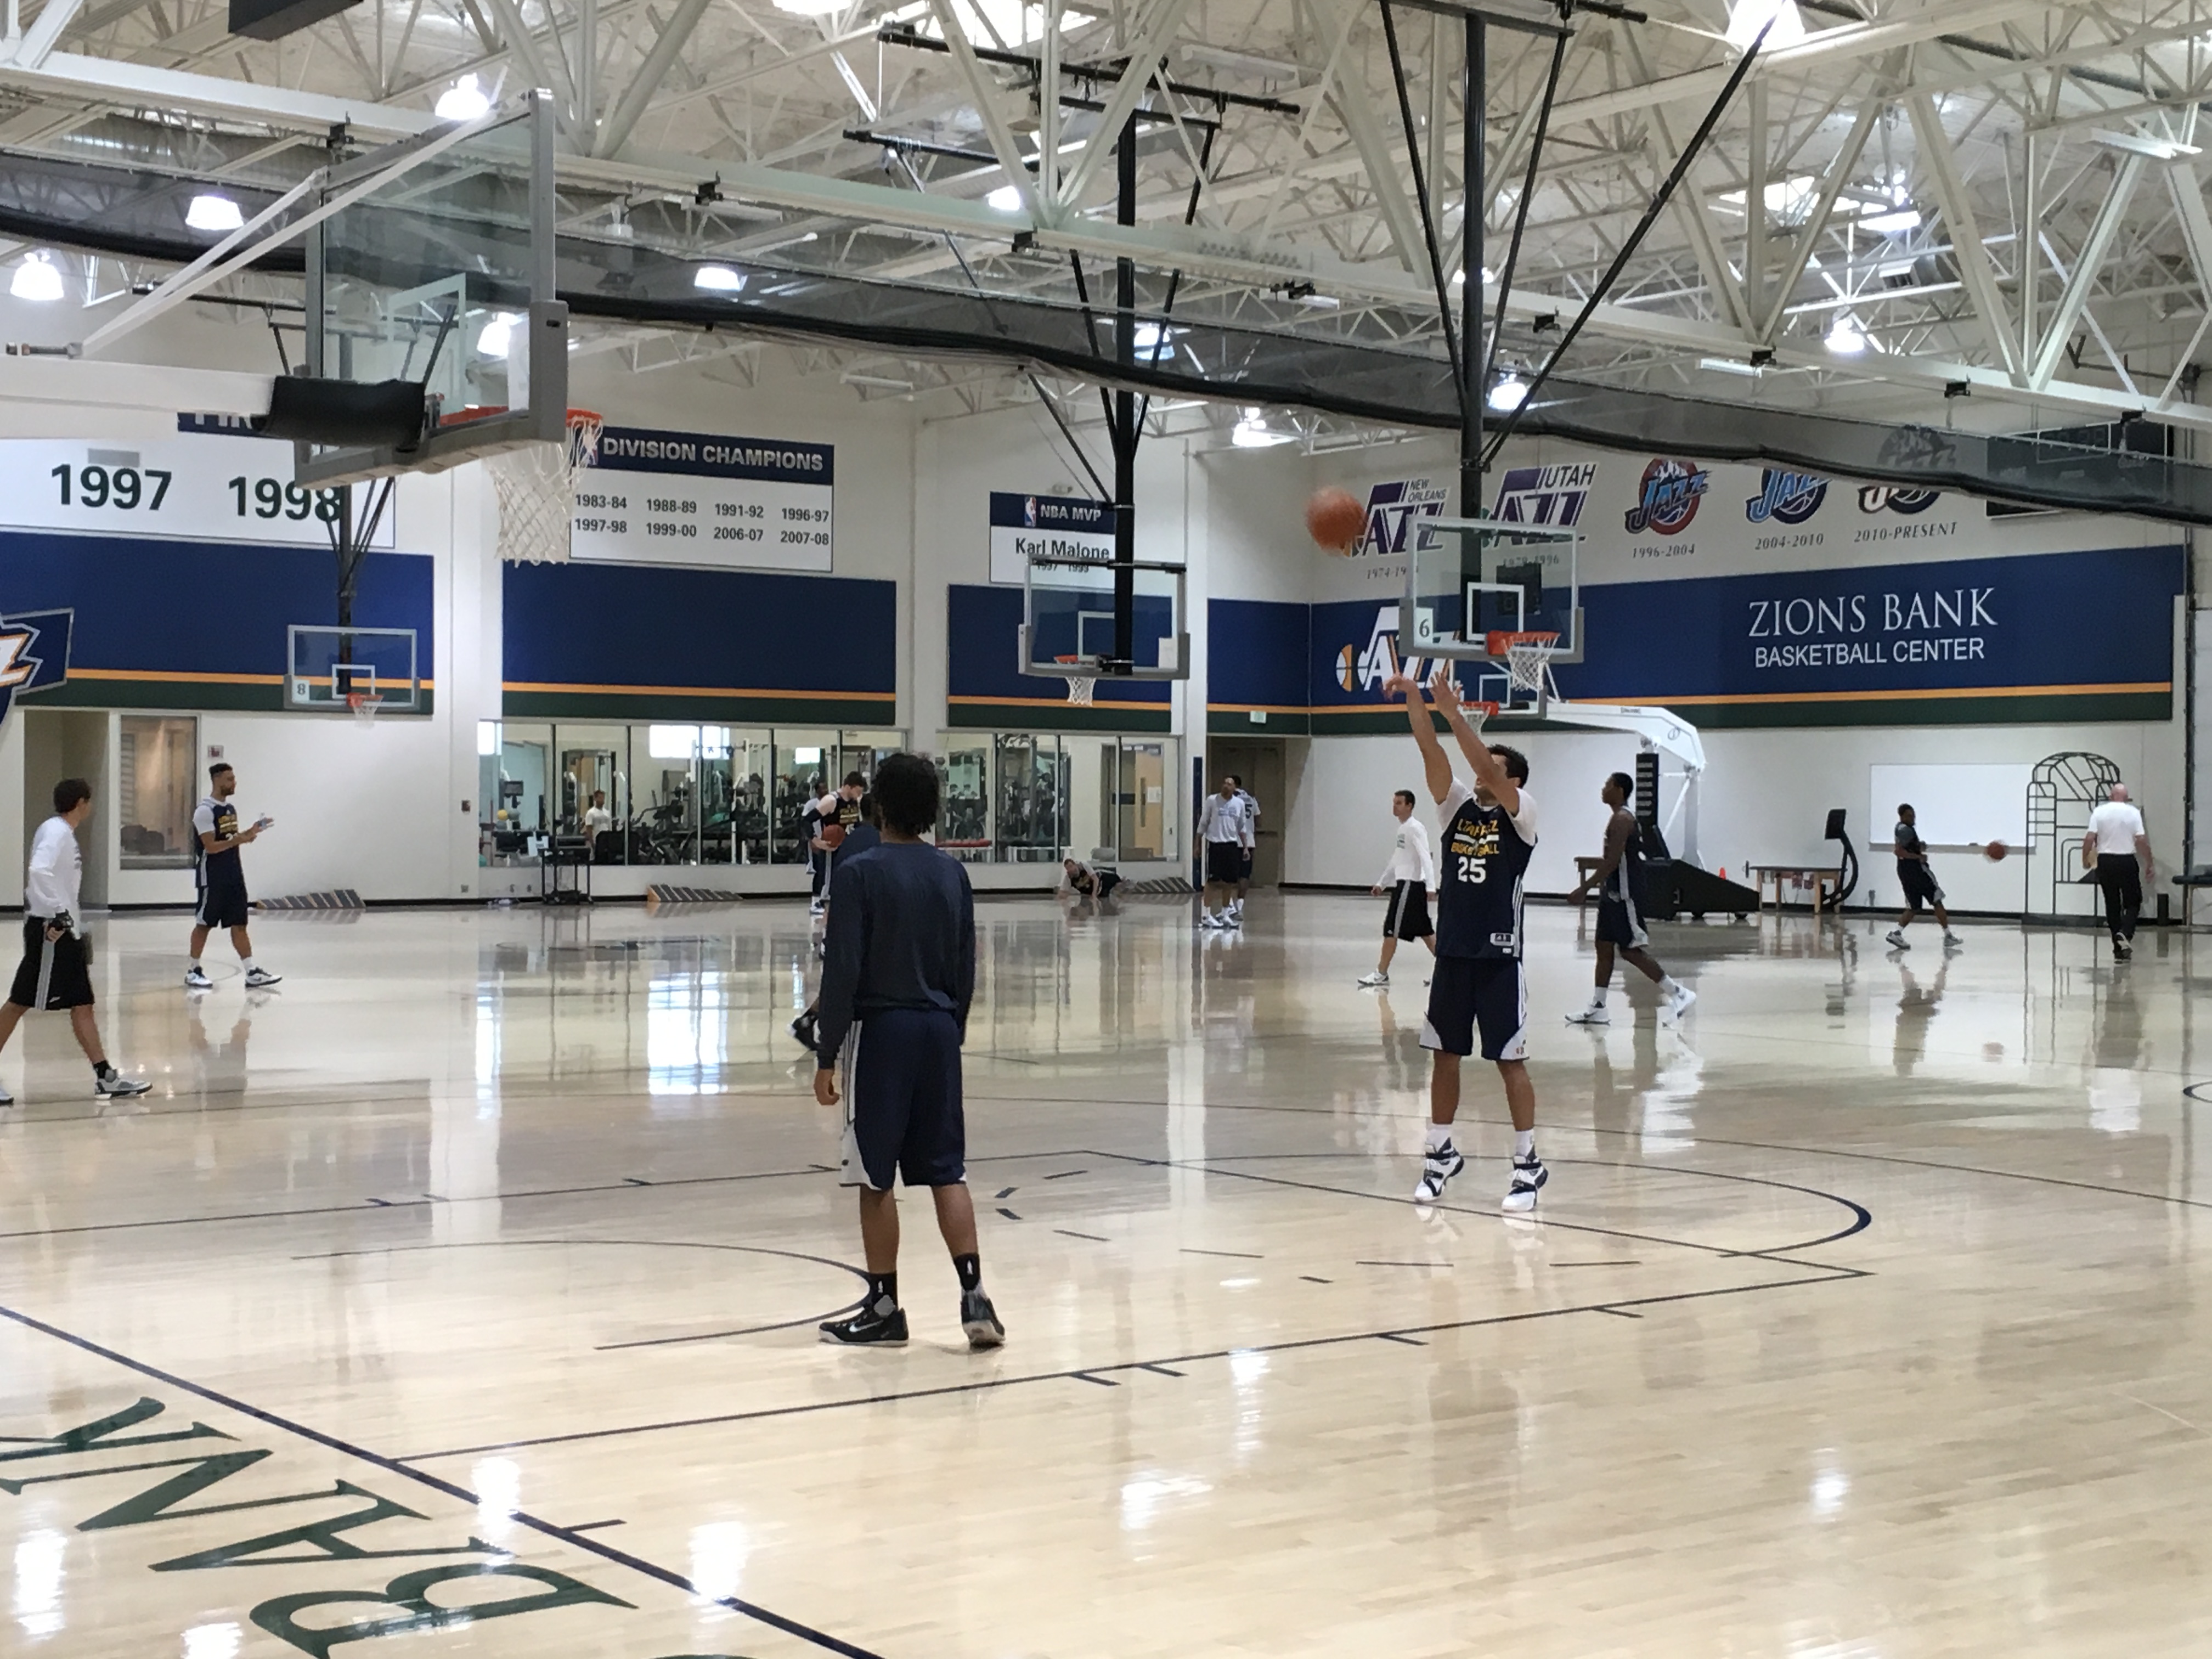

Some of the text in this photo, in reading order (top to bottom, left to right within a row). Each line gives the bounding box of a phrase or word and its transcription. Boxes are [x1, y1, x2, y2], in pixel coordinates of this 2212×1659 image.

[603, 437, 823, 472] DIVISION CHAMPIONS
[1410, 479, 1430, 490] NEW
[1544, 464, 1596, 488] UTAH
[51, 464, 341, 522] 1997 1998
[1408, 489, 1447, 503] ORLEANS
[1625, 470, 1712, 534] JAZZ
[575, 495, 829, 523] 1983-84 1988-89 1991-92 1996-97
[1040, 504, 1102, 522] NBA MVP
[574, 518, 829, 545] 1997-98 1999-00 2006-07 2007-08
[1754, 533, 1824, 550] 2004-2010
[1854, 522, 1957, 543] 2010-PRESENT
[1015, 537, 1110, 560] Karl Malone
[1632, 544, 1695, 558] 1996-2004
[1367, 565, 1419, 579] 1974-19
[1748, 587, 1999, 637] ZIONS BANK
[1419, 618, 1430, 638] 6
[1755, 637, 1985, 668] BASKETBALL CENTER
[297, 682, 306, 696] 8
[1458, 856, 1487, 884] 25
